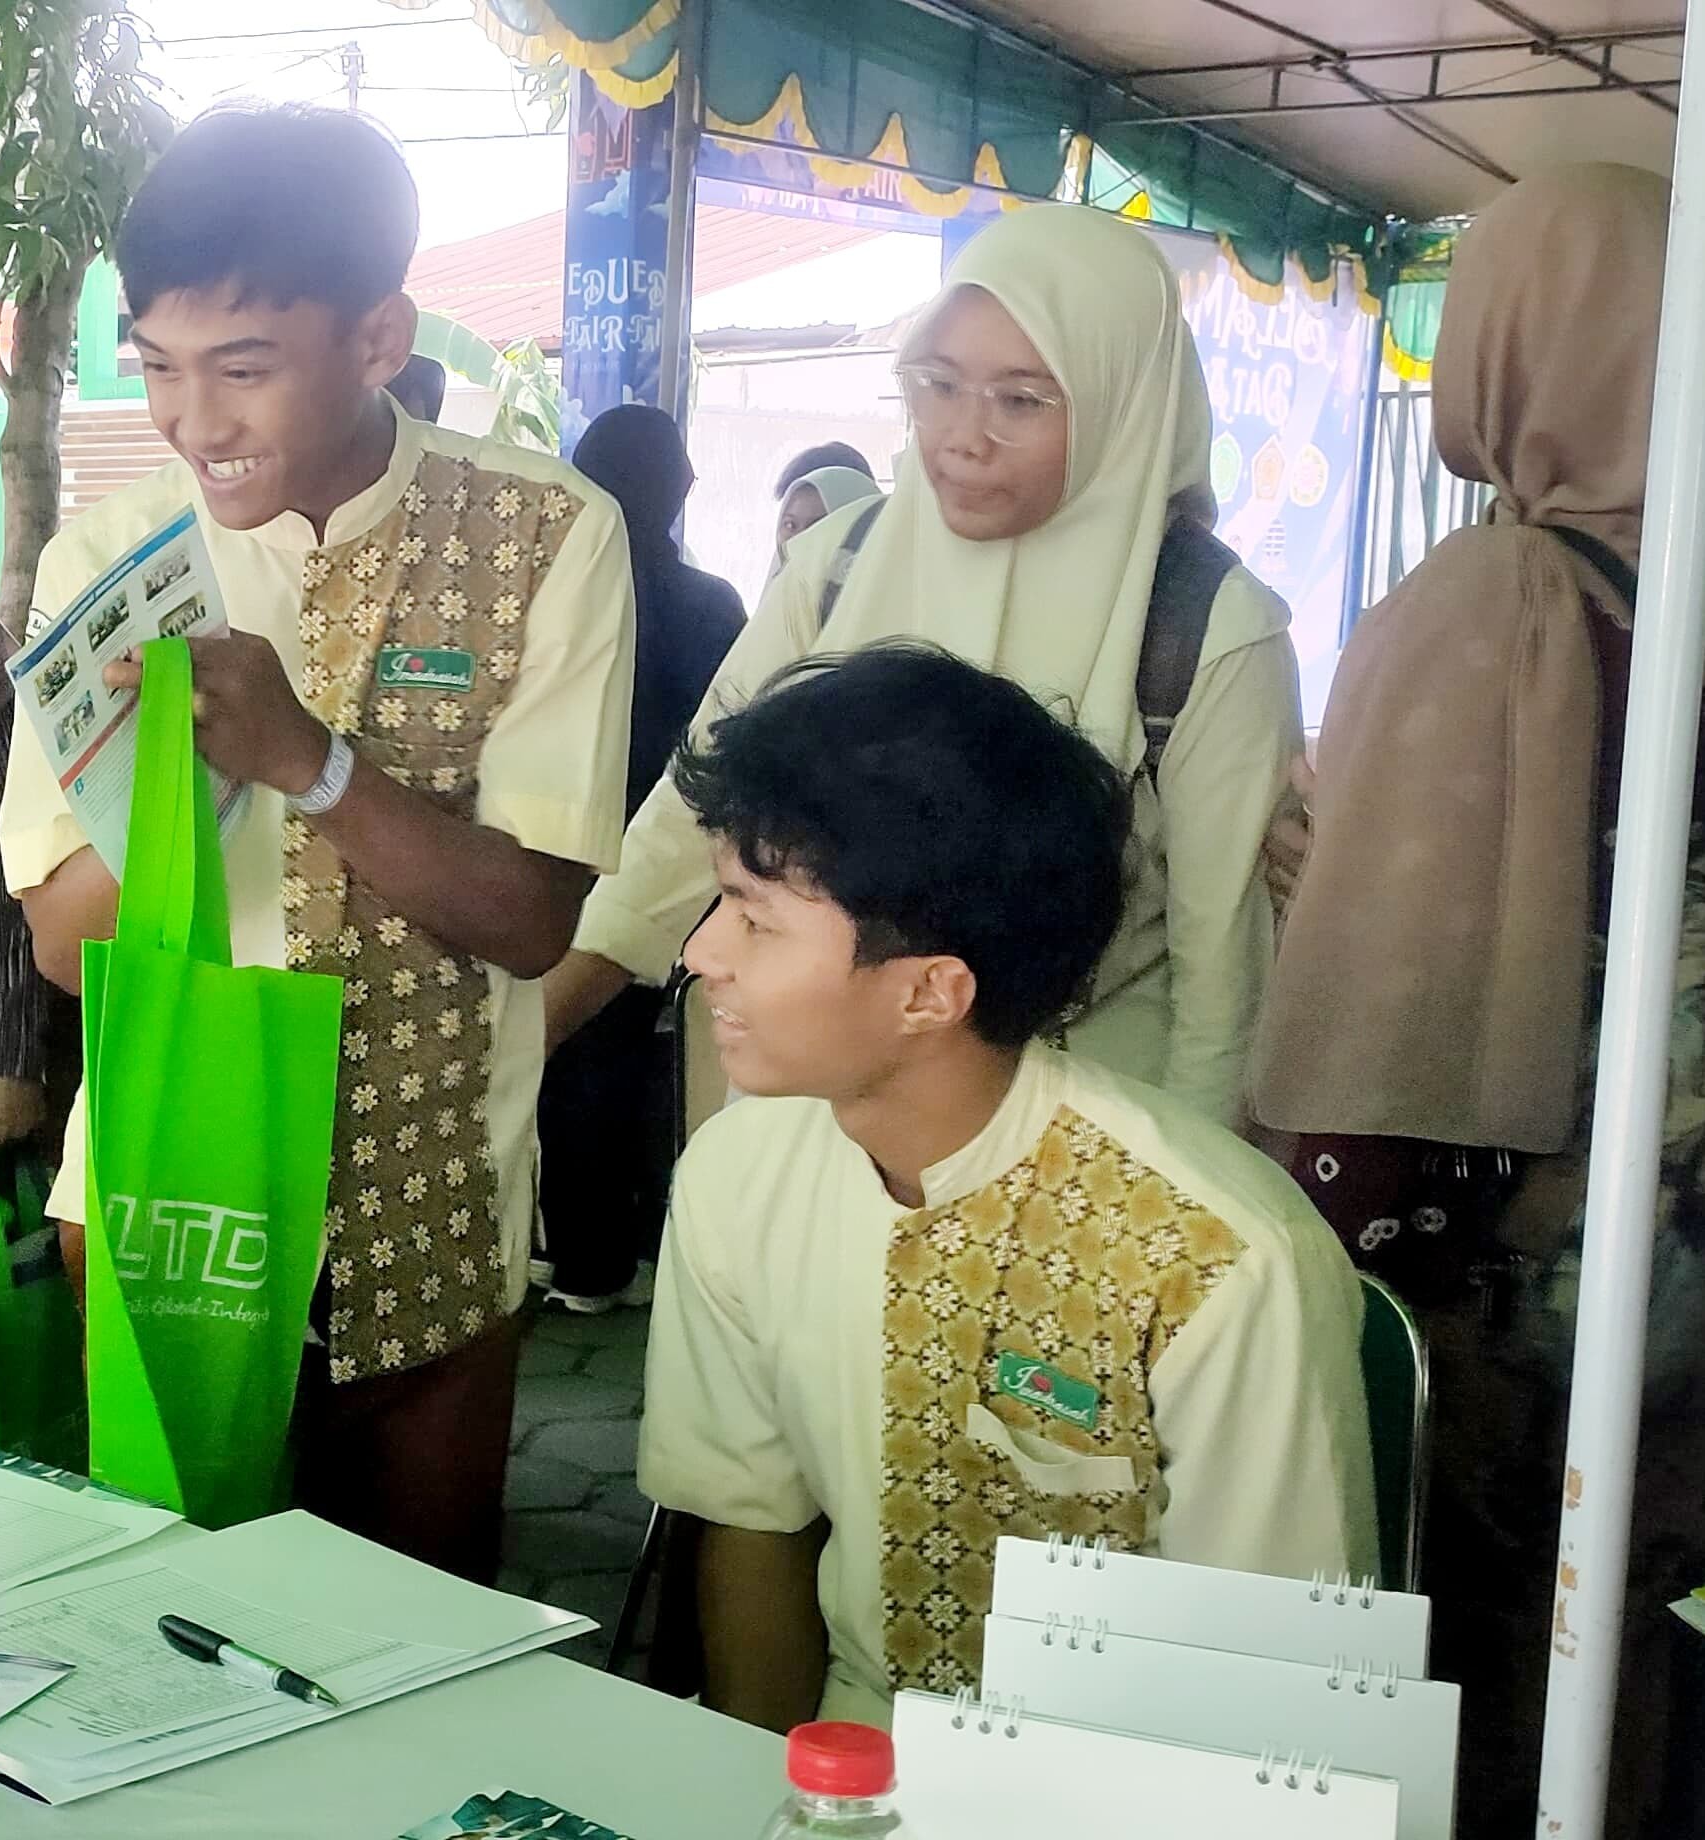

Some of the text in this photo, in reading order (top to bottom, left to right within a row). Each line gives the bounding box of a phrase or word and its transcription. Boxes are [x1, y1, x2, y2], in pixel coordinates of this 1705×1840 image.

[567, 257, 629, 311] EDU
[632, 259, 666, 312] ED
[563, 314, 626, 353] FAIR
[626, 314, 661, 352] FAI
